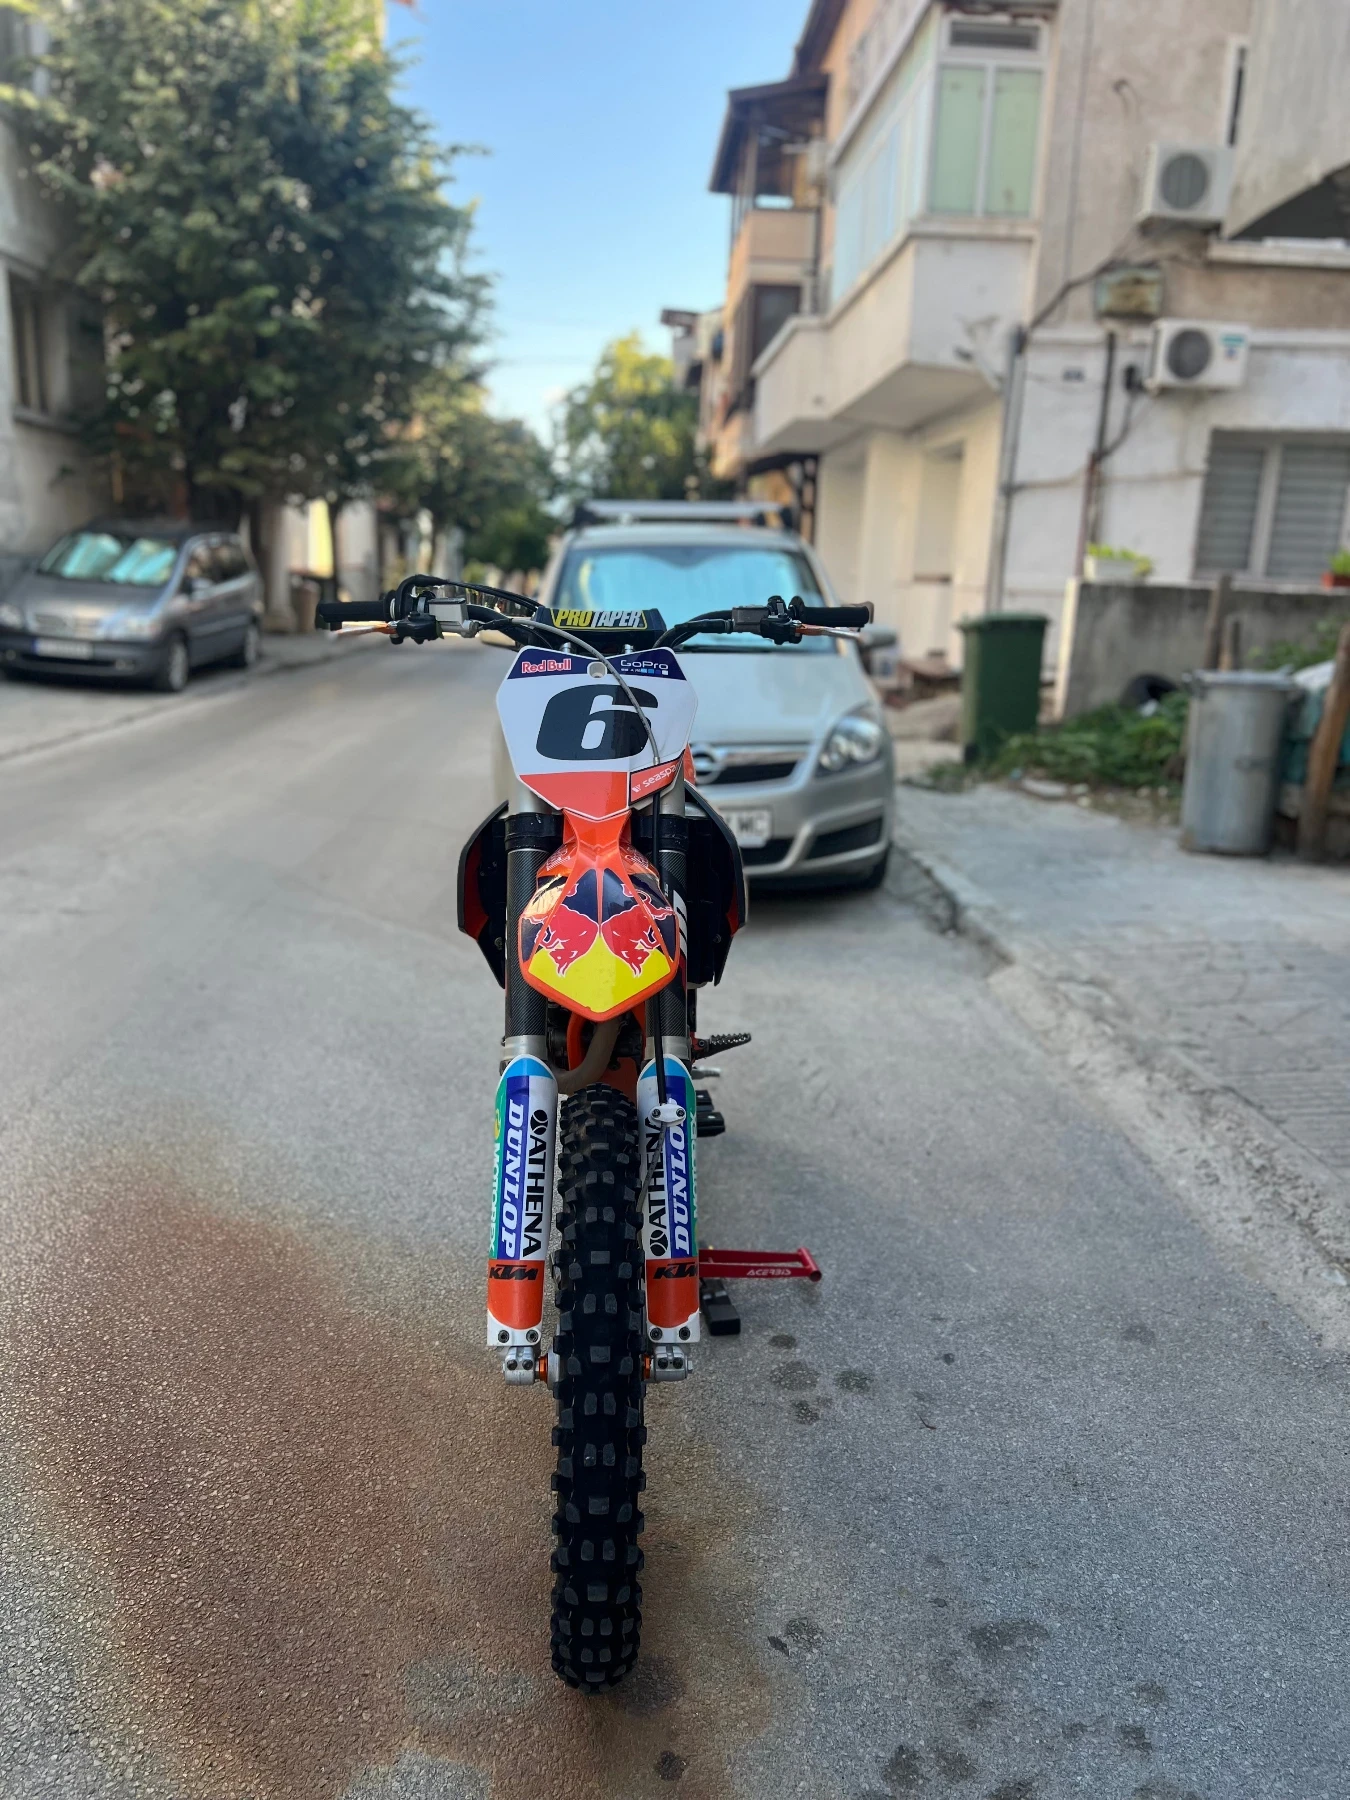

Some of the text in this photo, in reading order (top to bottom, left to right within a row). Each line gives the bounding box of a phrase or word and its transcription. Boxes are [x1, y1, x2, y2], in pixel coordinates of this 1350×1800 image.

[522, 658, 572, 674] Red Bull
[620, 659, 669, 670] GoPro
[536, 683, 658, 761] 6
[502, 1098, 524, 1258] DUNLOP
[523, 1134, 547, 1258] ATHENA
[669, 1097, 690, 1256] DUNLO
[489, 1264, 539, 1281] KTM
[746, 1268, 791, 1276] ACERBIS
